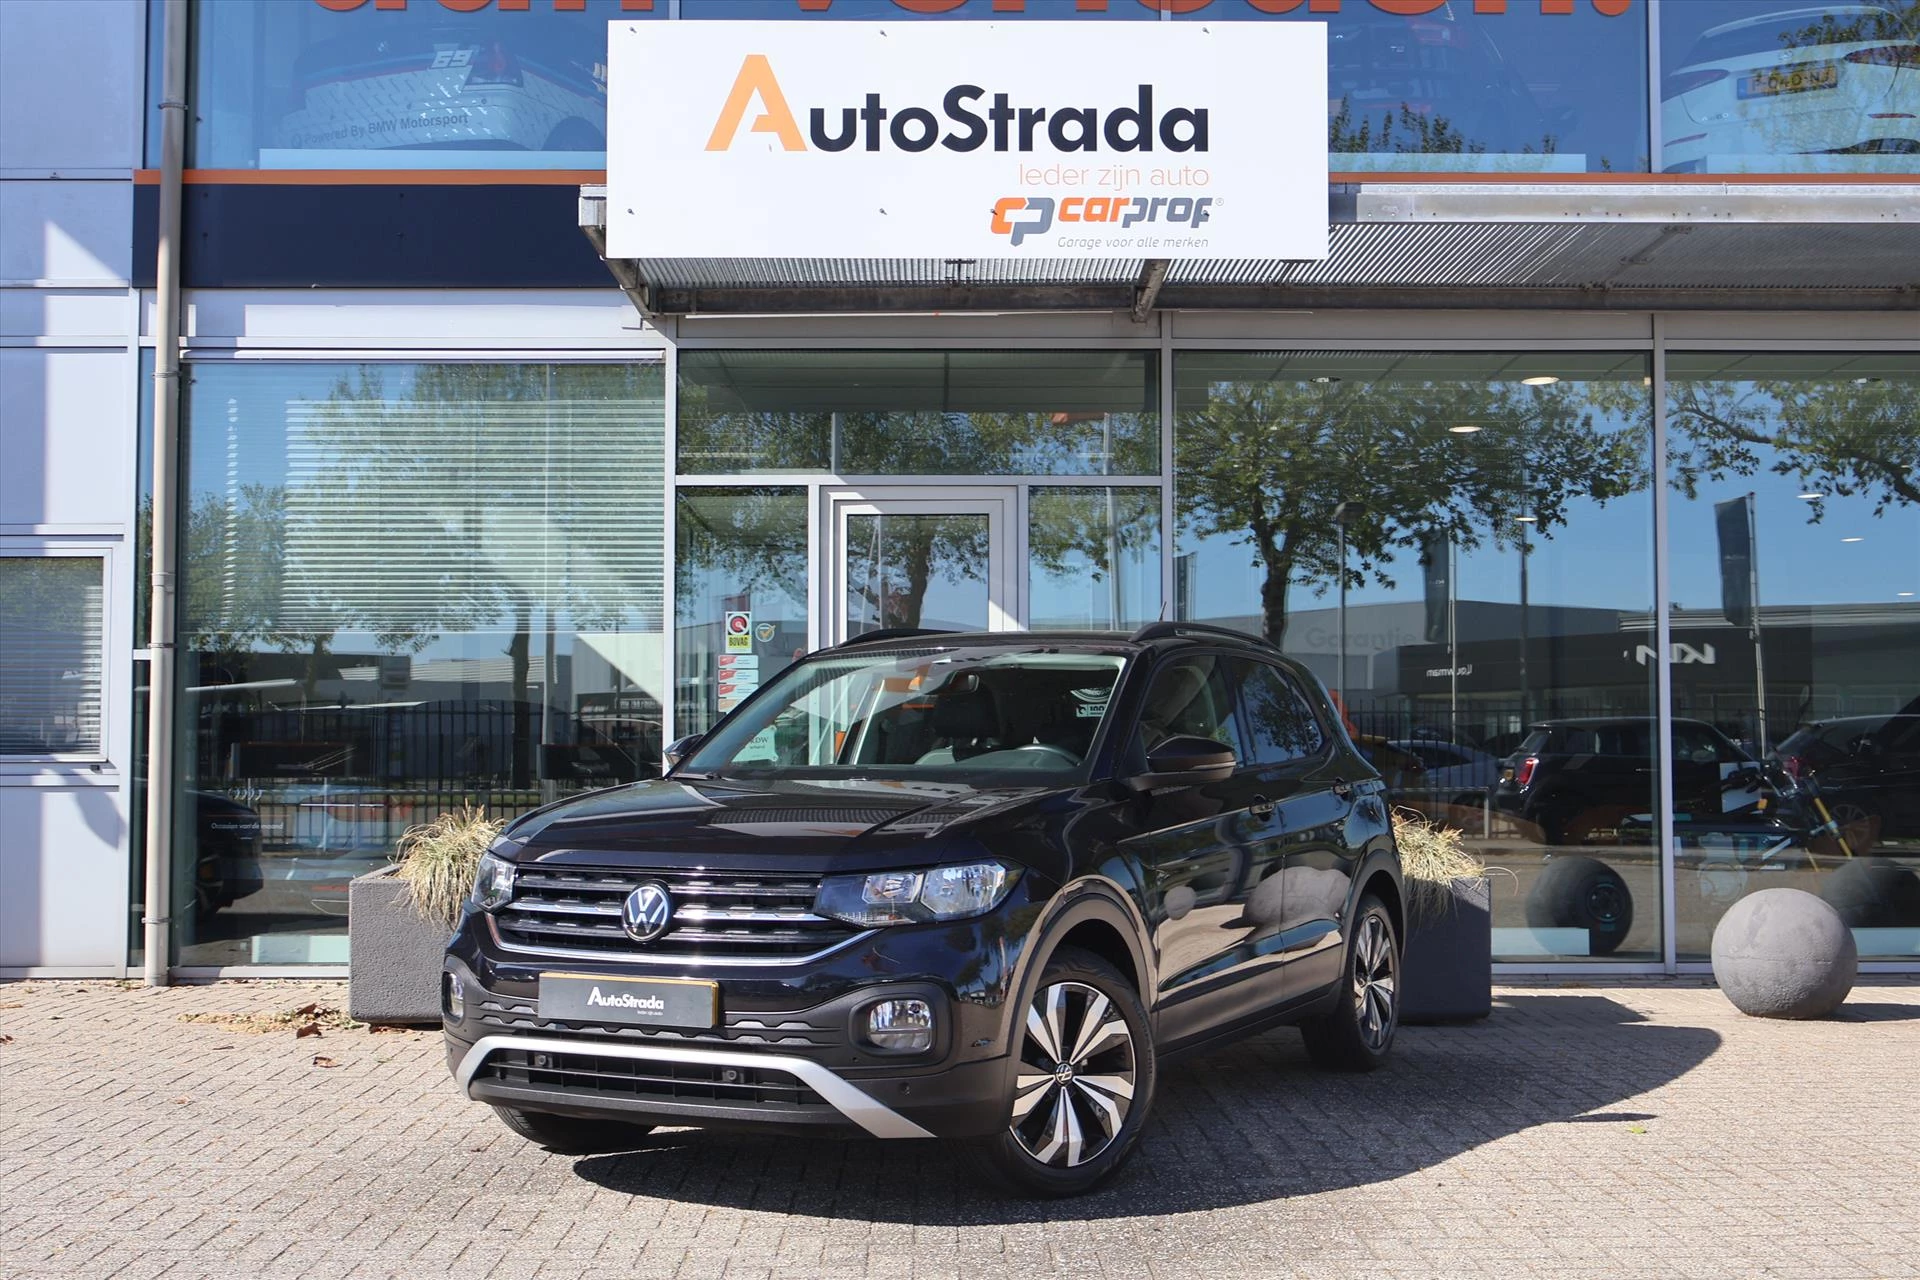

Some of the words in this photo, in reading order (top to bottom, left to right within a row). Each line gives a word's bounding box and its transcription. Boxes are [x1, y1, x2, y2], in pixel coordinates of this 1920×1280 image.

[431, 50, 473, 69] 69
[704, 54, 1209, 153] AutoStrada
[351, 124, 365, 139] By
[368, 119, 397, 134] BMW
[400, 112, 469, 130] Motorsport
[1019, 163, 1089, 186] Ieder
[1098, 164, 1141, 191] zijn
[1150, 165, 1210, 186] auto
[1057, 236, 1102, 250] Garage
[1106, 238, 1134, 248] voor
[1137, 236, 1160, 248] alle
[1163, 236, 1209, 248] merken
[587, 986, 665, 1010] AutoStrada
